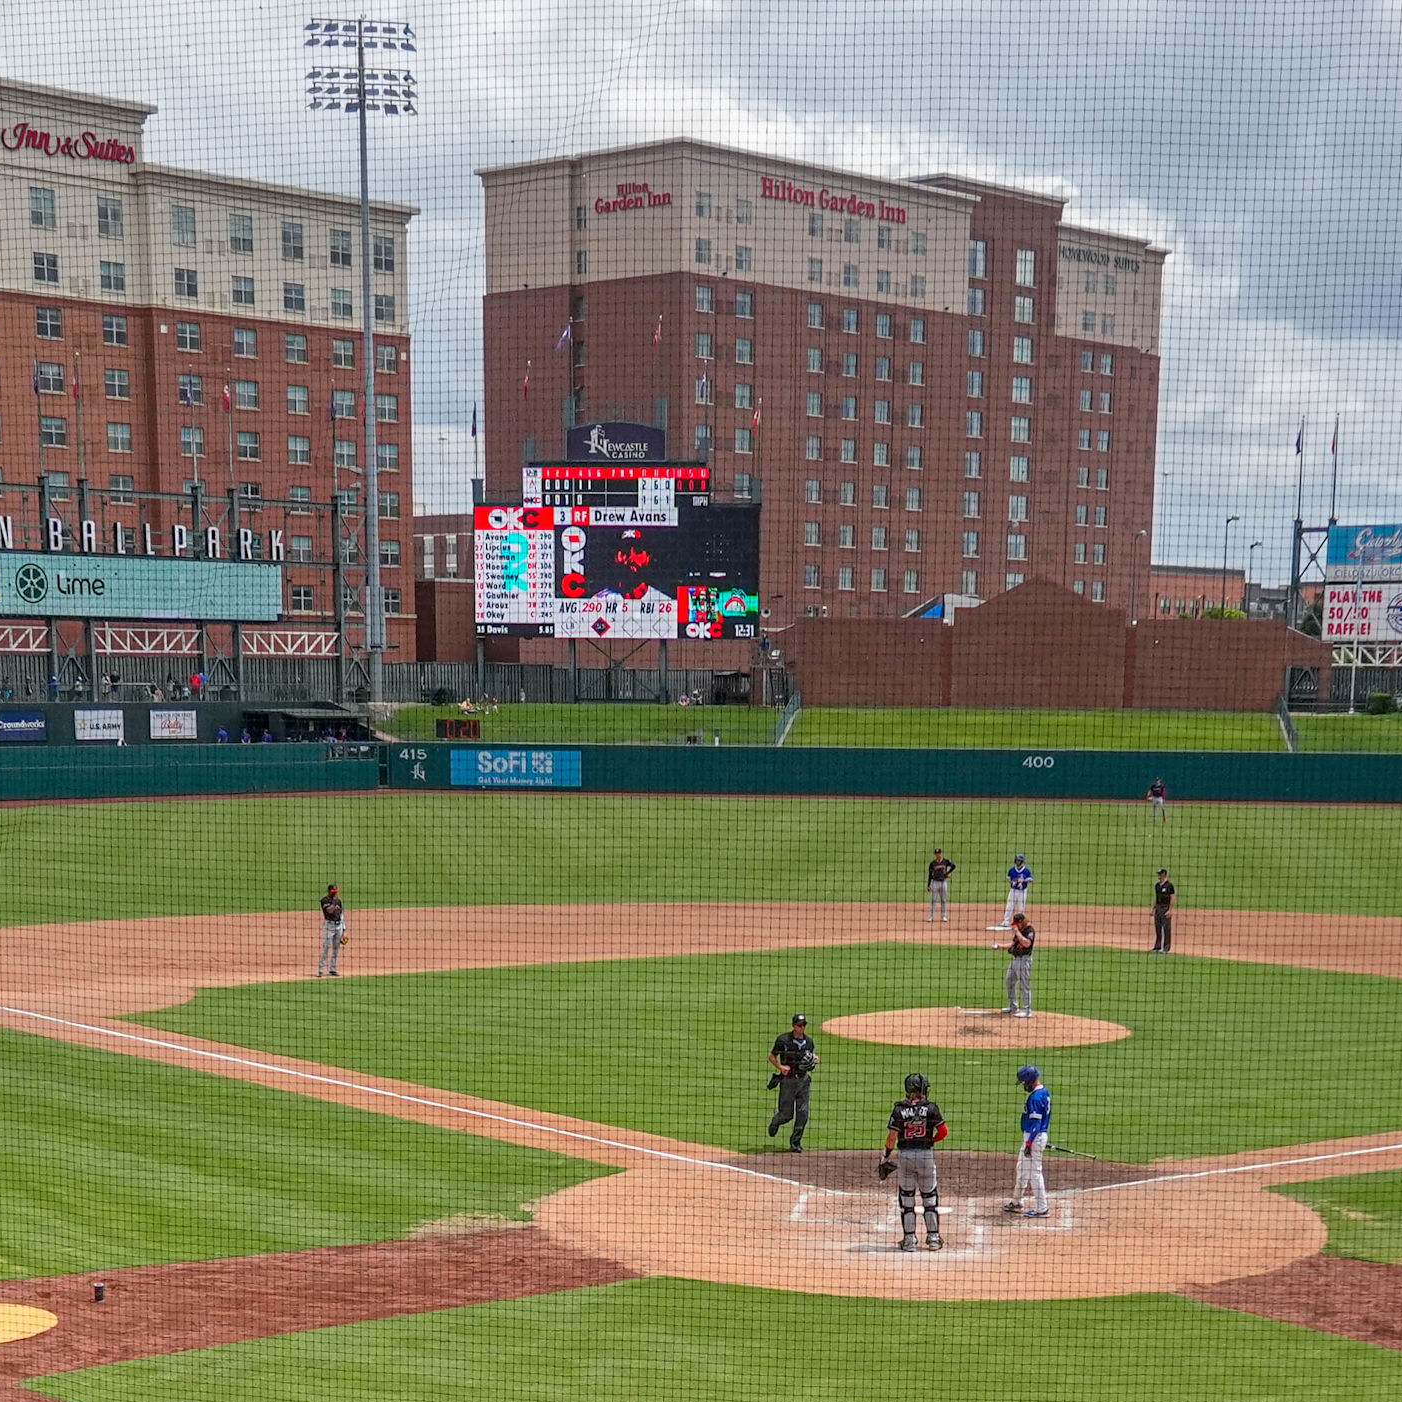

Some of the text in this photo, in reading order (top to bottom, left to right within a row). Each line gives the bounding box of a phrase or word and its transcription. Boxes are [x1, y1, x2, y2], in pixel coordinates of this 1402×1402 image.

[2, 122, 60, 155] Inn
[62, 137, 75, 158] &
[74, 132, 136, 164] Suites
[617, 183, 648, 195] Hilton
[595, 191, 671, 214] Garden Inn
[761, 177, 906, 224] Hilton Garden Inn
[692, 496, 708, 506] MPH
[488, 508, 539, 529] OKC
[560, 510, 666, 522] 3 RF Drew Avans
[48, 517, 285, 561] BALLPARK
[486, 573, 518, 581] Sweeney
[1362, 590, 1382, 603] THE
[559, 602, 577, 613] AVG
[606, 602, 617, 613] HR
[622, 602, 628, 612] 5
[640, 602, 654, 613] RBI
[659, 603, 672, 612] 26
[486, 612, 505, 620] Okey
[486, 625, 508, 633] Davis
[686, 622, 722, 639] OKC
[1327, 623, 1371, 635] RAFFE!
[399, 749, 427, 760] 415
[478, 751, 526, 774] SoFi
[1022, 756, 1054, 768] 400
